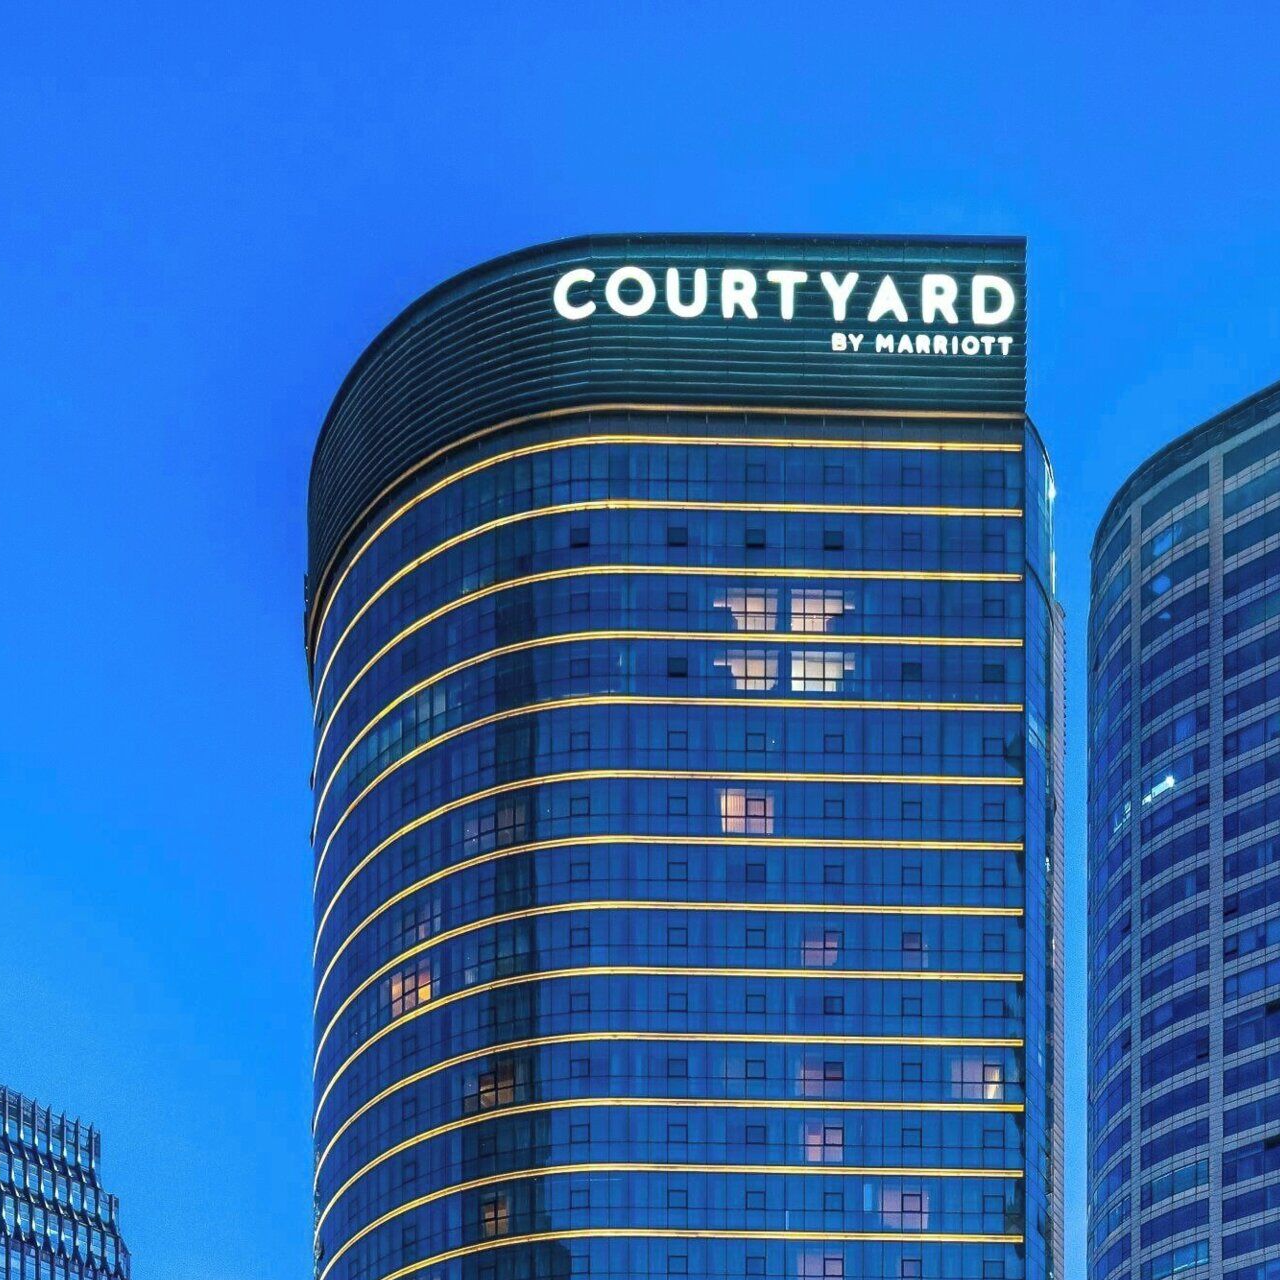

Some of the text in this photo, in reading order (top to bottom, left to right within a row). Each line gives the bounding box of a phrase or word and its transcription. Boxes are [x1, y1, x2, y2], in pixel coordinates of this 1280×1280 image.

[553, 266, 1016, 325] COURTYARD
[831, 332, 1014, 356] BY MARRIOTT
